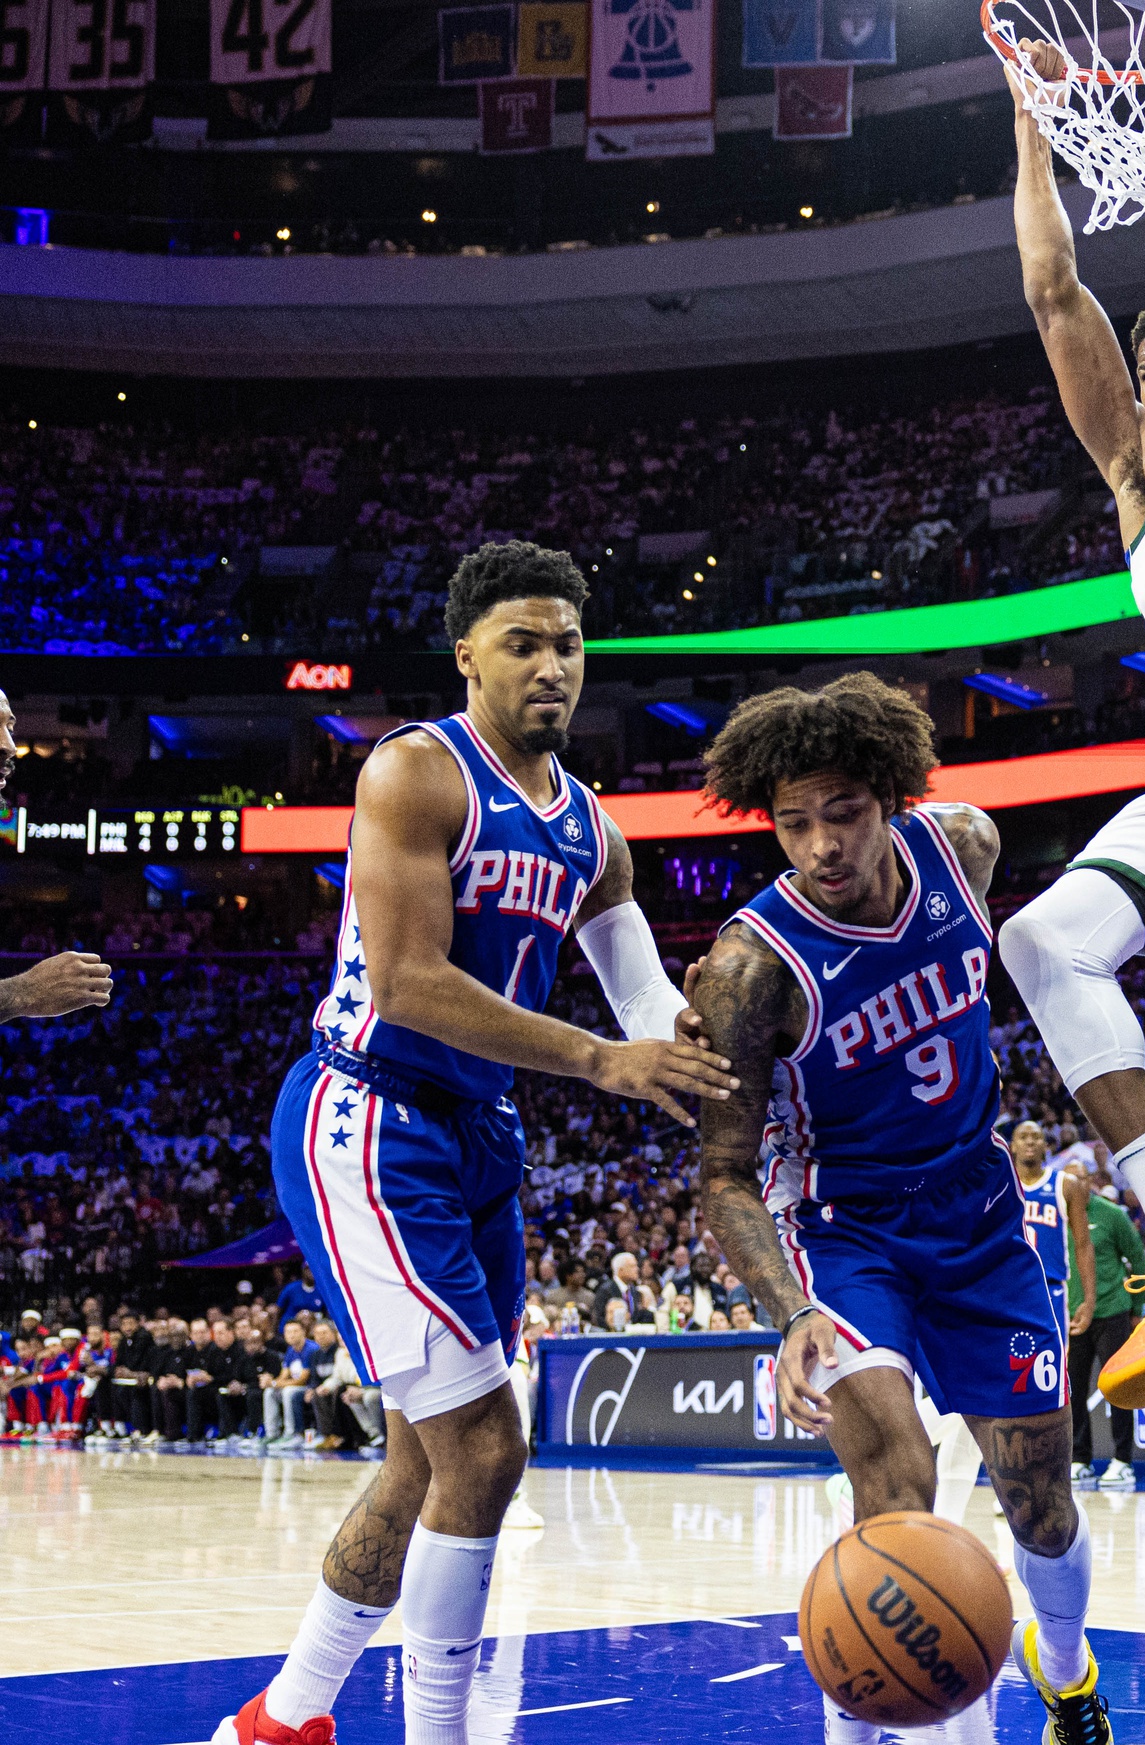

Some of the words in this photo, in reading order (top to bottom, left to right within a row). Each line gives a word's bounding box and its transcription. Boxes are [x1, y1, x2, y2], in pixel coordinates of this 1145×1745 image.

[221, 0, 314, 72] 42
[286, 662, 351, 690] AON
[27, 822, 60, 838] 7:49
[61, 823, 86, 839] PM
[138, 837, 151, 852] 4
[166, 837, 179, 852] 0
[139, 822, 151, 837] 4
[166, 822, 179, 837] 0
[197, 822, 206, 837] 1
[927, 913, 967, 942] crypto.com
[825, 946, 988, 1069] PHILA
[905, 1034, 959, 1106] 9
[1009, 1350, 1058, 1393] 76
[673, 1380, 744, 1414] KIA
[867, 1574, 970, 1698] Wilson
